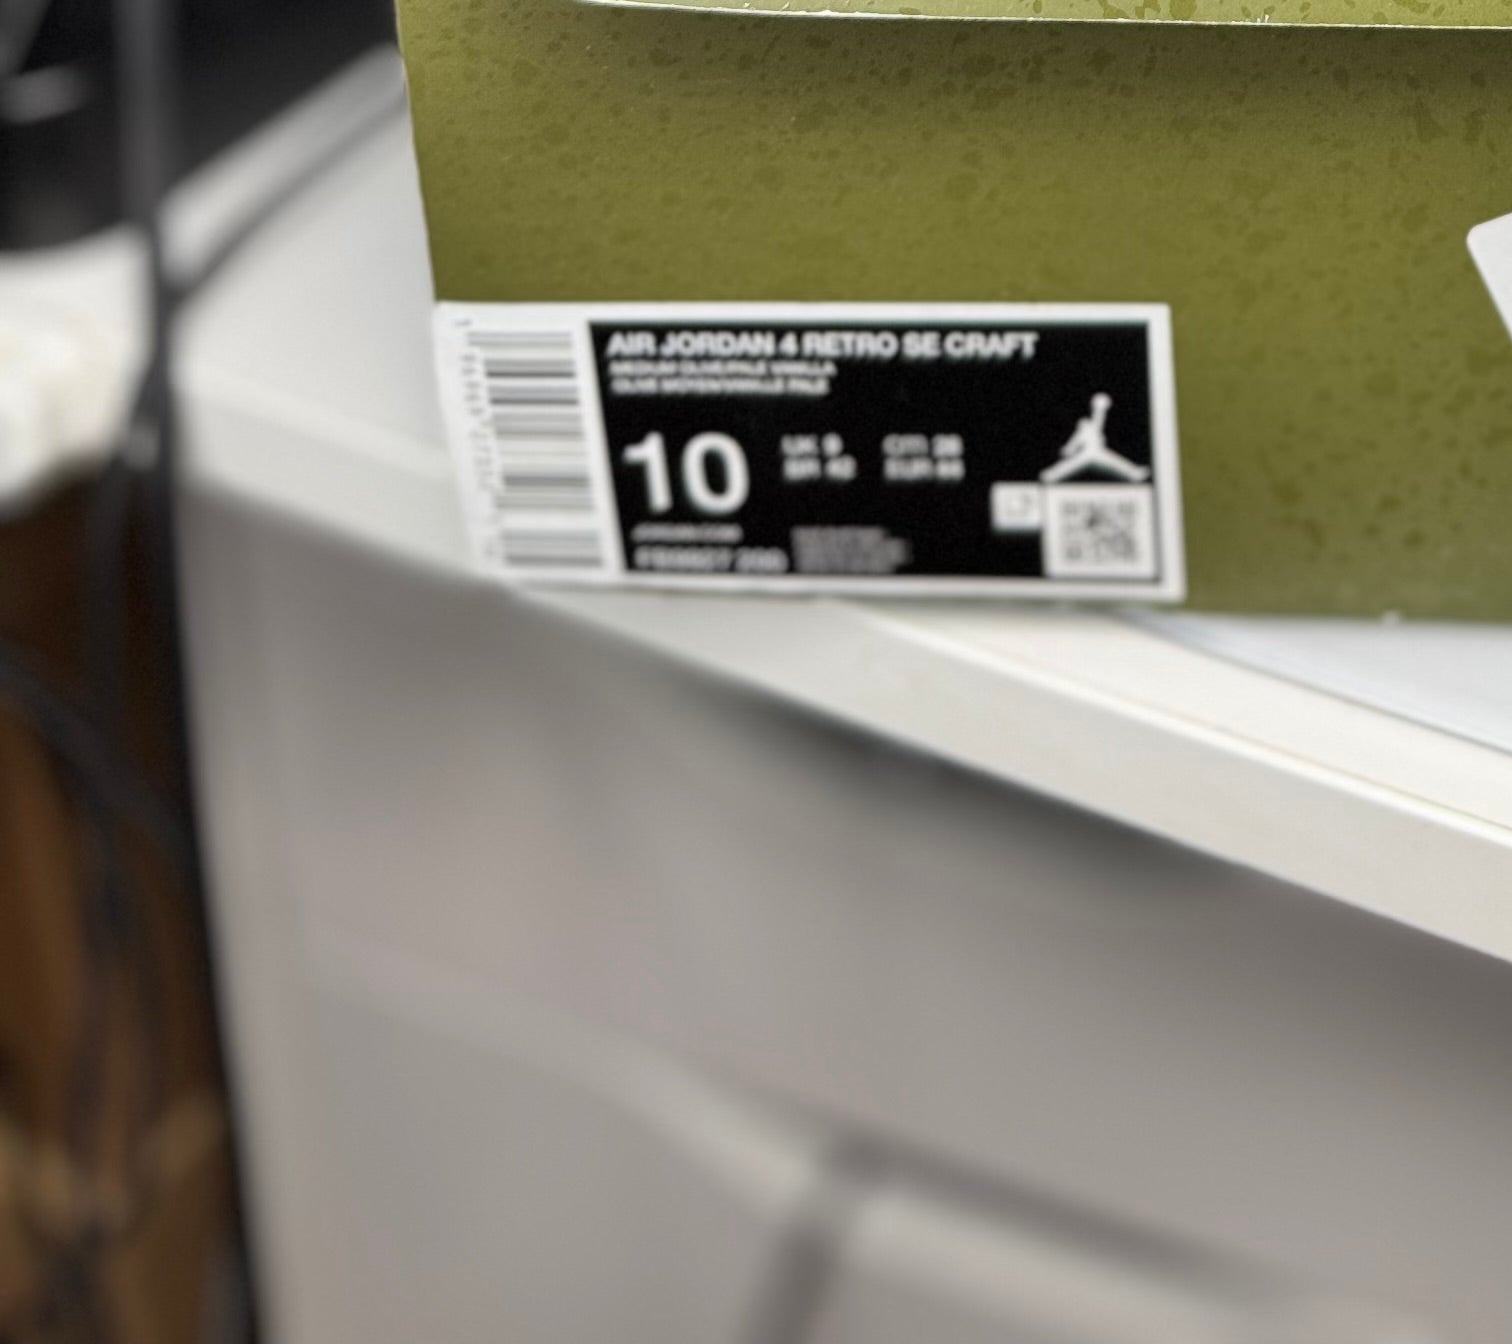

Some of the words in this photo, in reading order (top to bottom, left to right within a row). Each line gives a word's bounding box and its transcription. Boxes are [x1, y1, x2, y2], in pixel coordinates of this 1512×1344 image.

[606, 331, 657, 356] AIR
[659, 331, 775, 356] JORDAN
[778, 331, 799, 356] 4
[802, 331, 899, 357] RETRO
[901, 331, 941, 358] SE
[944, 331, 1039, 359] CRAFT
[623, 431, 750, 514] 10
